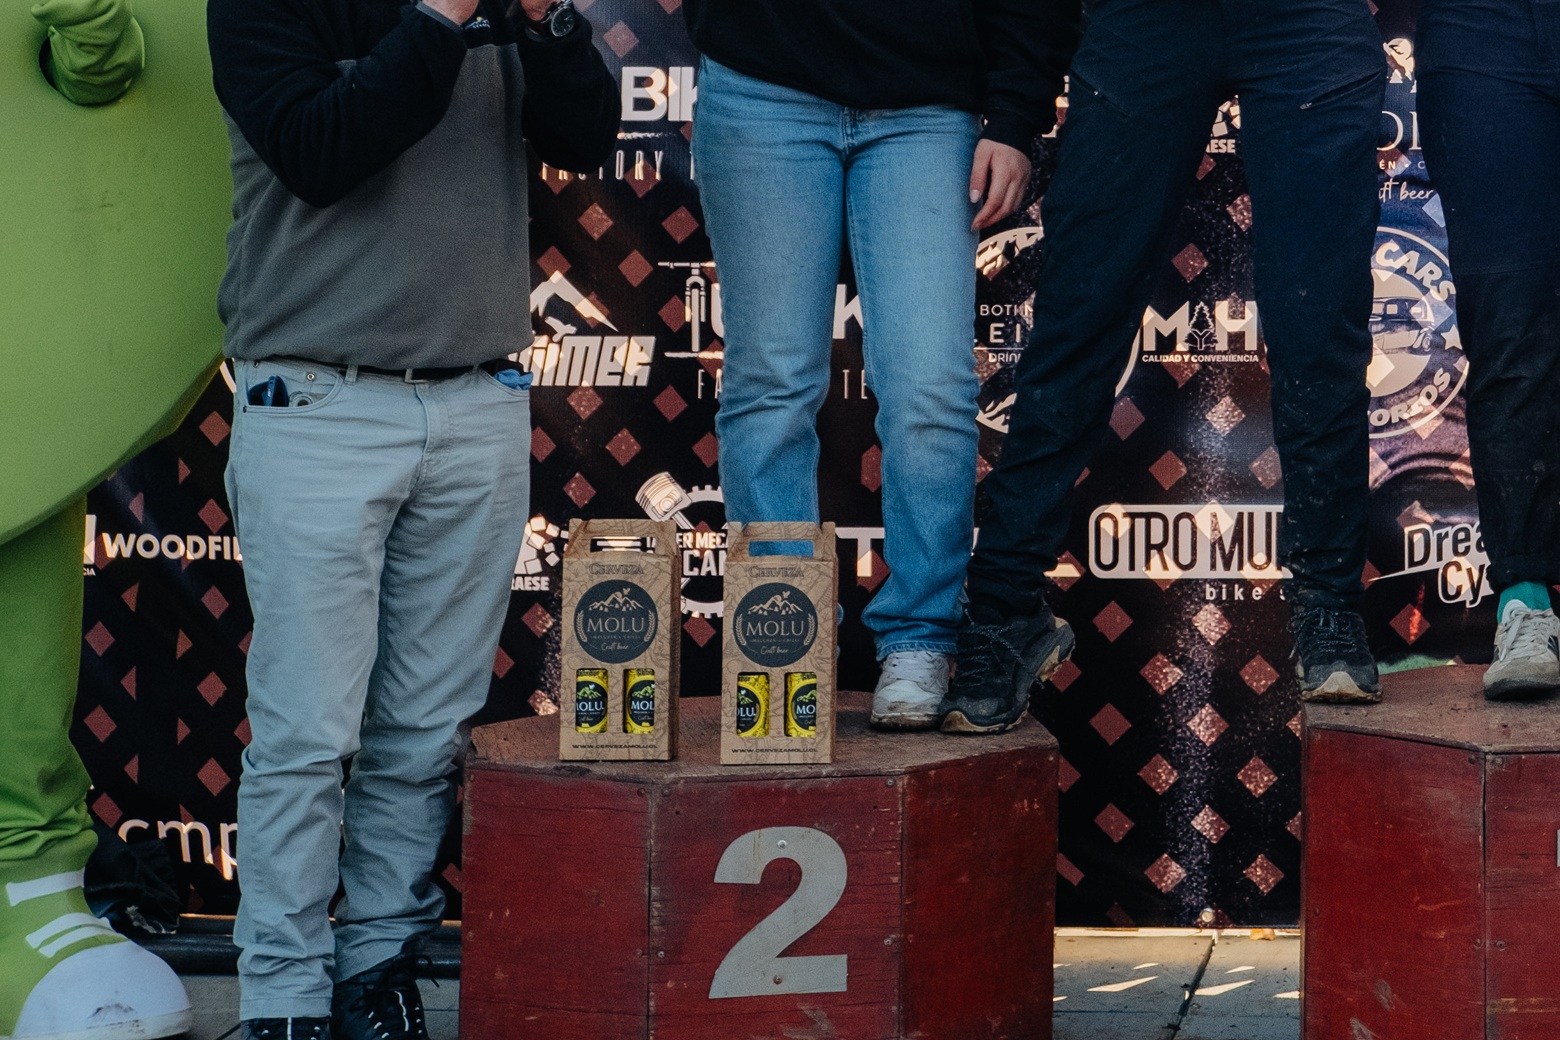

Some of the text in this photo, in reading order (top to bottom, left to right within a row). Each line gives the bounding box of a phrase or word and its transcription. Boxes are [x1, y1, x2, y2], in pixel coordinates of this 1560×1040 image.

[1400, 181, 1434, 202] beer
[1142, 354, 1259, 363] CALIDAD Y CONVENIENCIA
[1369, 367, 1451, 427] ORIOS
[102, 532, 243, 561] WOODFI
[1094, 511, 1197, 572] OTRO
[589, 563, 644, 575] CERVEZA
[748, 566, 804, 578] CERVEZA
[1205, 584, 1263, 602] bike
[587, 617, 645, 633] MOLU
[745, 620, 805, 637] MOLU
[709, 826, 848, 1000] 2
